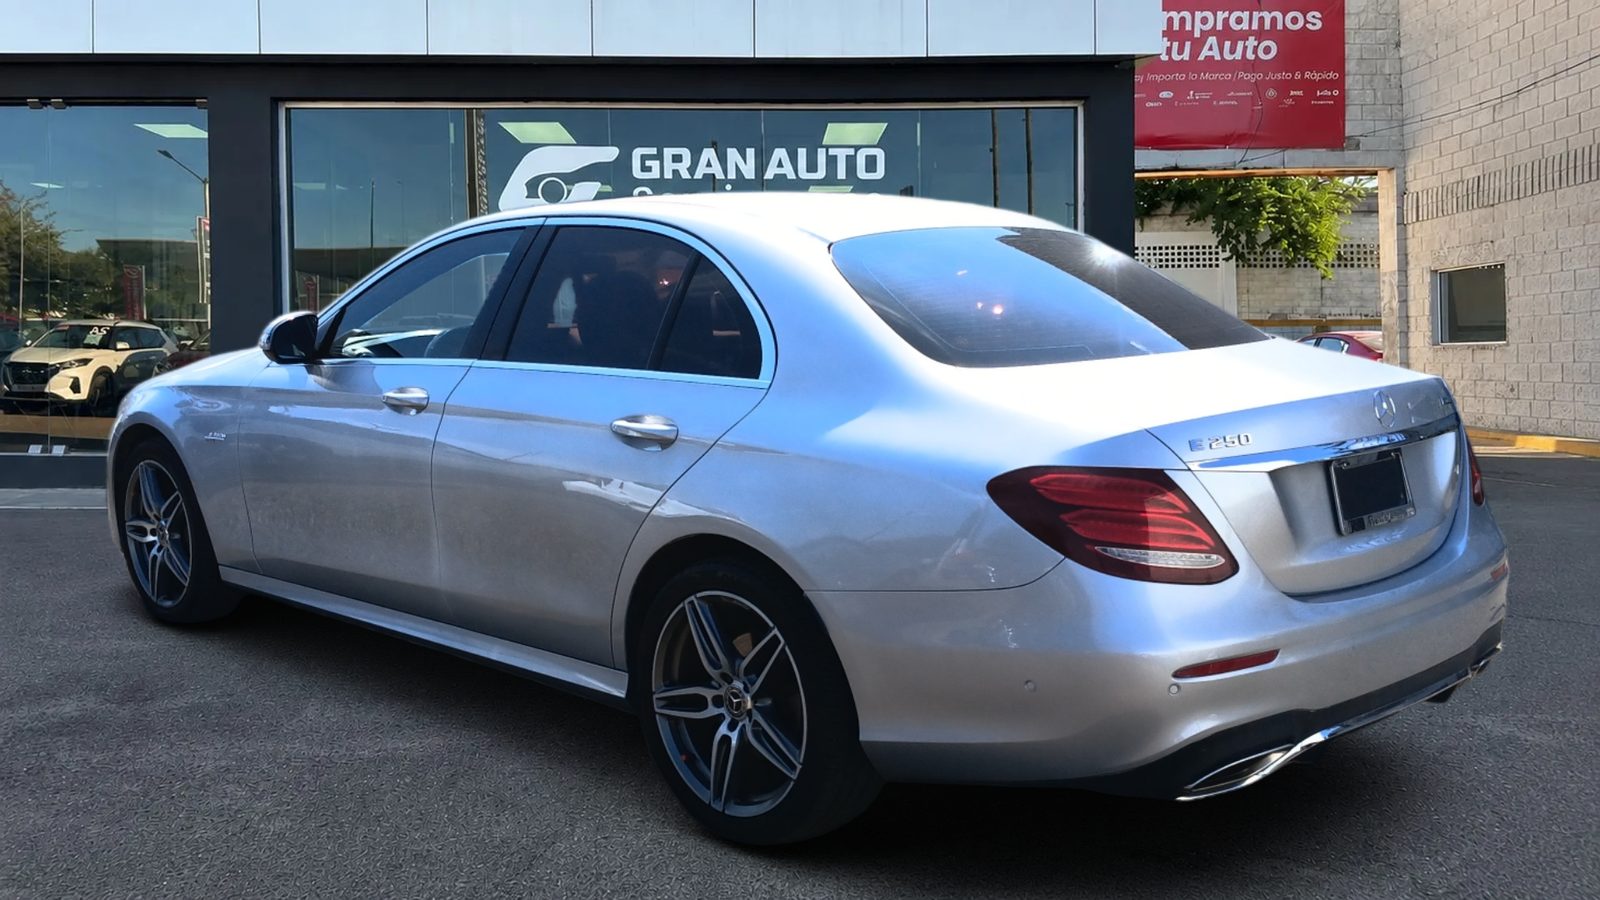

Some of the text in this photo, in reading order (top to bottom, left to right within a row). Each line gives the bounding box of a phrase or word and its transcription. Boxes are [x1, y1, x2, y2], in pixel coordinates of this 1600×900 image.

[1160, 36, 1278, 61] tu Auto
[1147, 73, 1186, 83] Importa
[1188, 72, 1198, 80] la
[1200, 72, 1232, 80] Marca
[1265, 72, 1292, 80] Justo
[1294, 71, 1301, 80] &
[631, 147, 886, 180] GRAN AUTO
[1188, 433, 1252, 452] E 250
